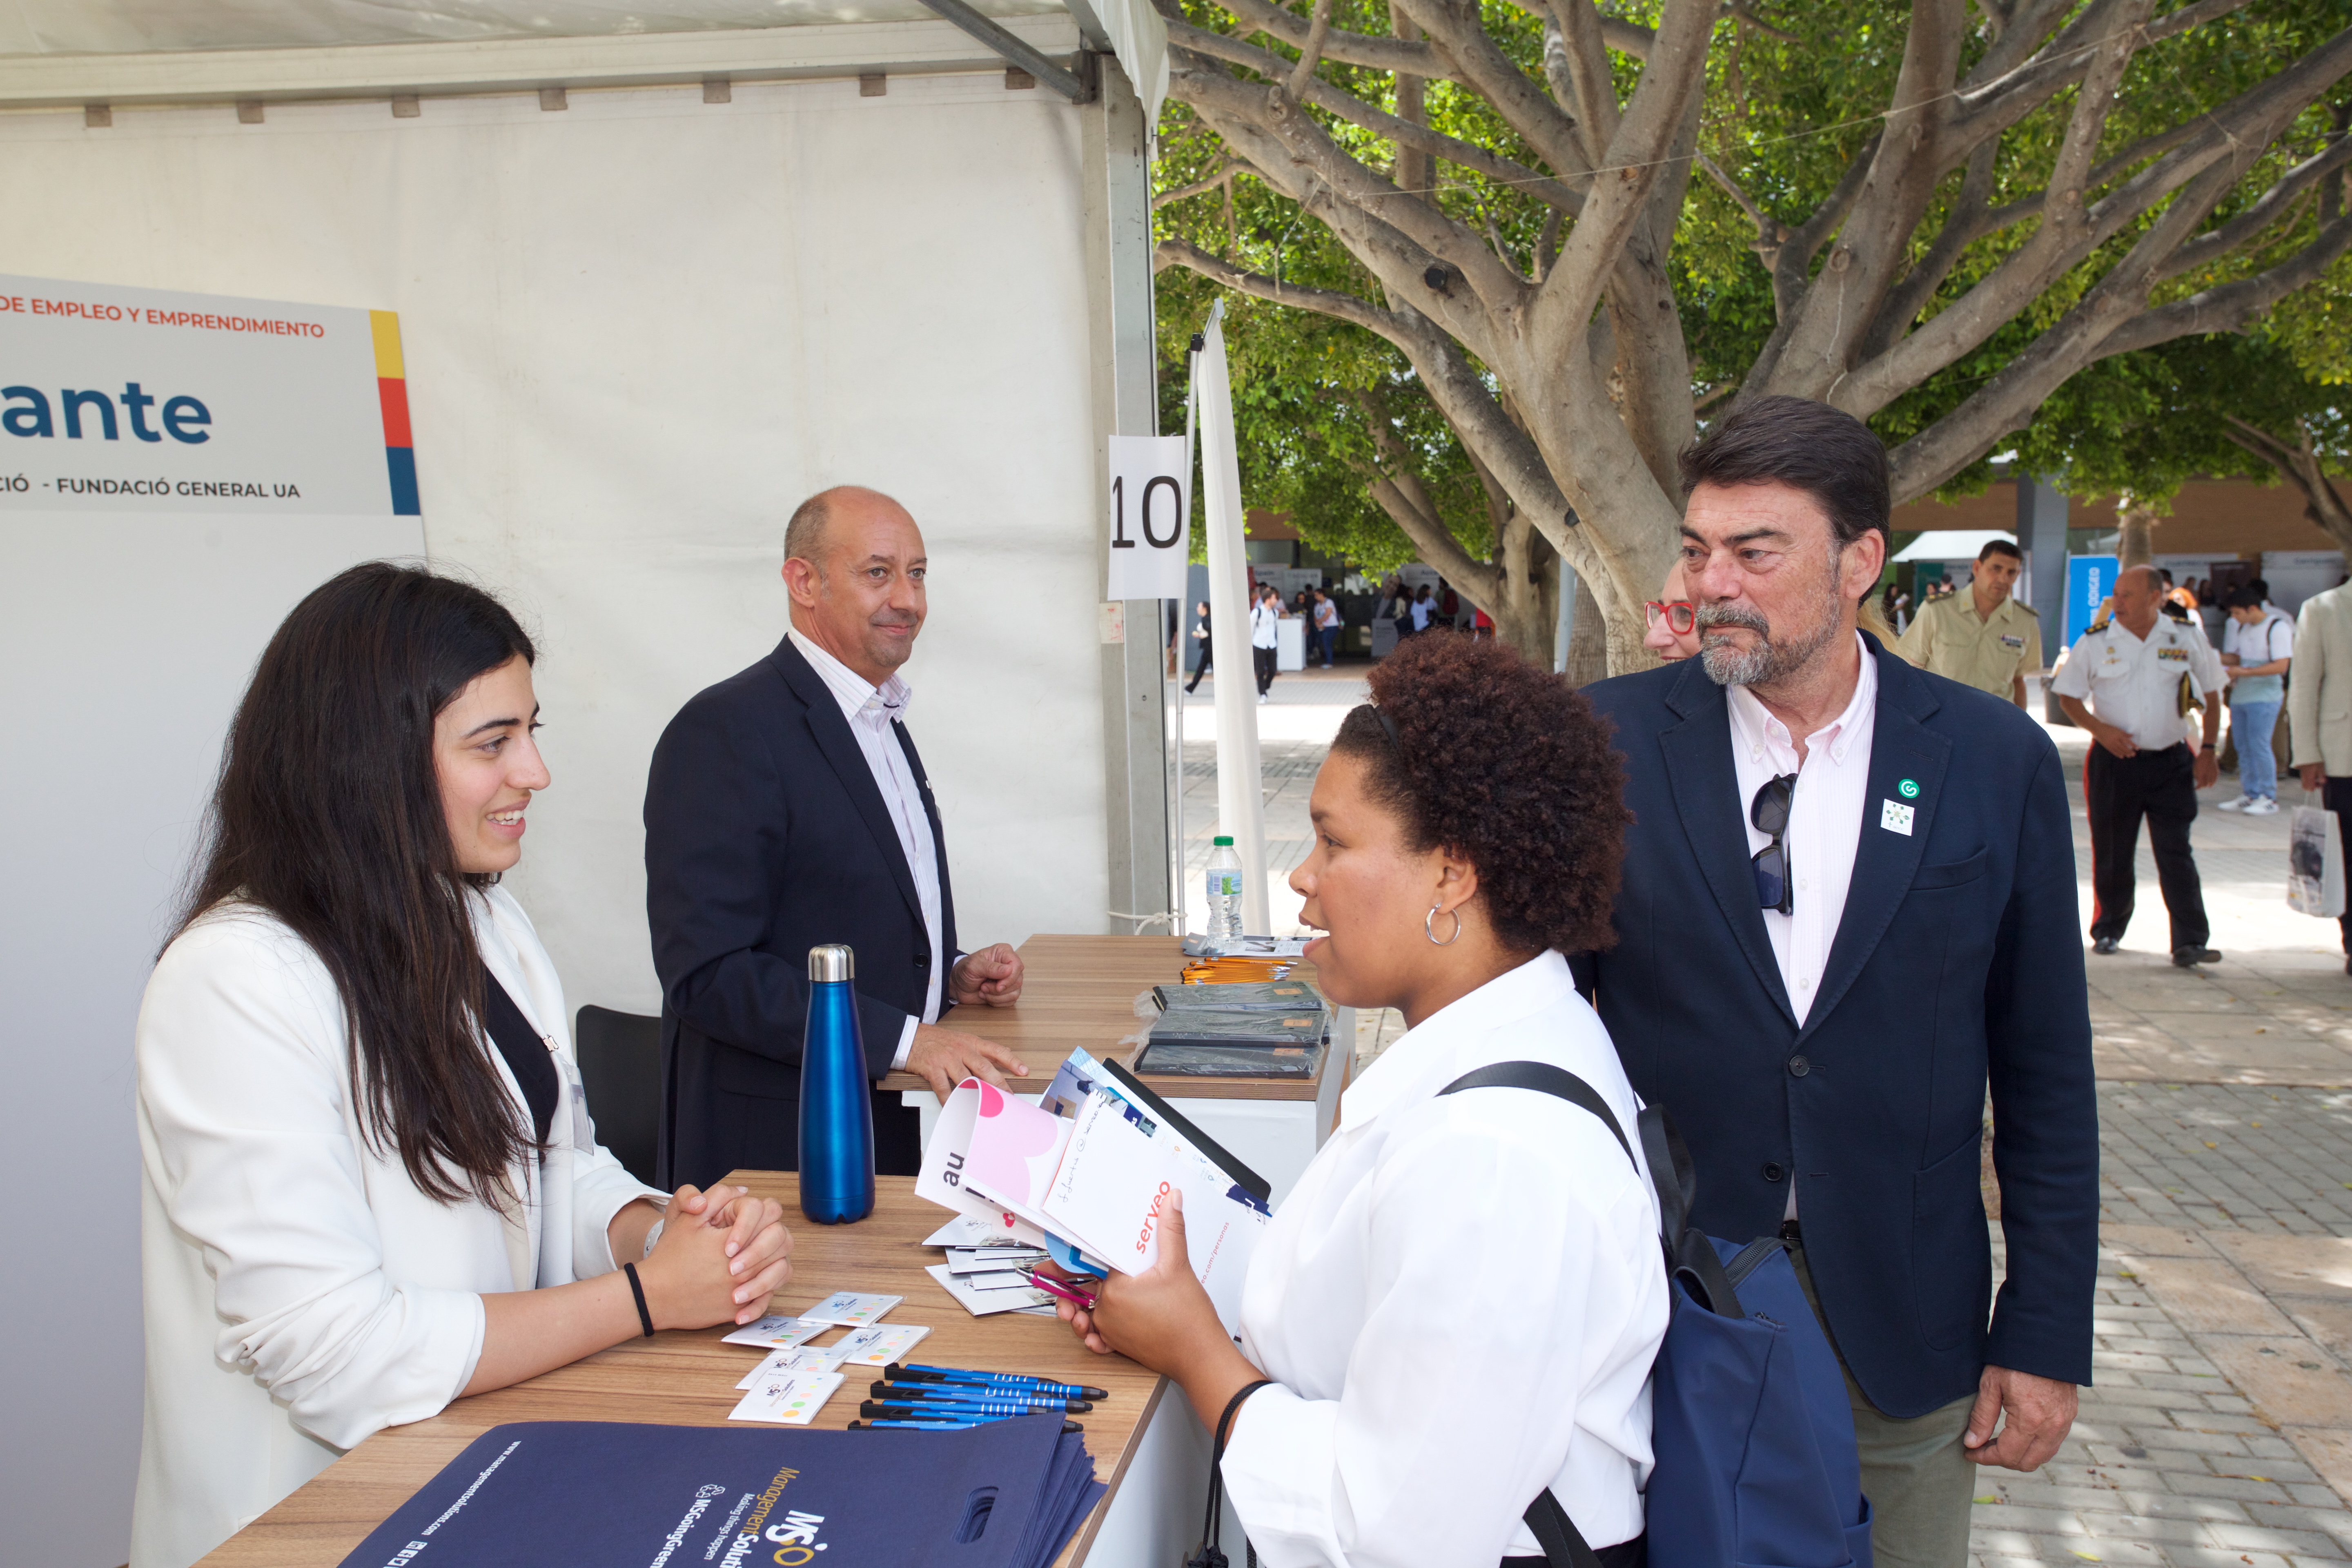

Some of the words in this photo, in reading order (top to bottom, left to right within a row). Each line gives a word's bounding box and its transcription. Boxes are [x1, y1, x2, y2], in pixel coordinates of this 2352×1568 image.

[31, 298, 122, 321] EMPLEO
[127, 307, 140, 323] Y
[146, 309, 325, 338] EMPRENDIMIENTO
[0, 382, 212, 444] ante
[0, 473, 29, 492] IÓ
[57, 477, 170, 495] FUNDACIÓ
[176, 481, 269, 497] GENERAL
[273, 483, 301, 498] UA
[1112, 476, 1182, 548] 10
[943, 1152, 964, 1187] au
[1136, 1181, 1170, 1254] serveo
[421, 1441, 521, 1535] www.managementsolutions.com
[730, 1493, 755, 1515] Making
[650, 1499, 711, 1568] MSGoingGreen
[719, 1515, 740, 1535] things
[704, 1535, 728, 1560] happen
